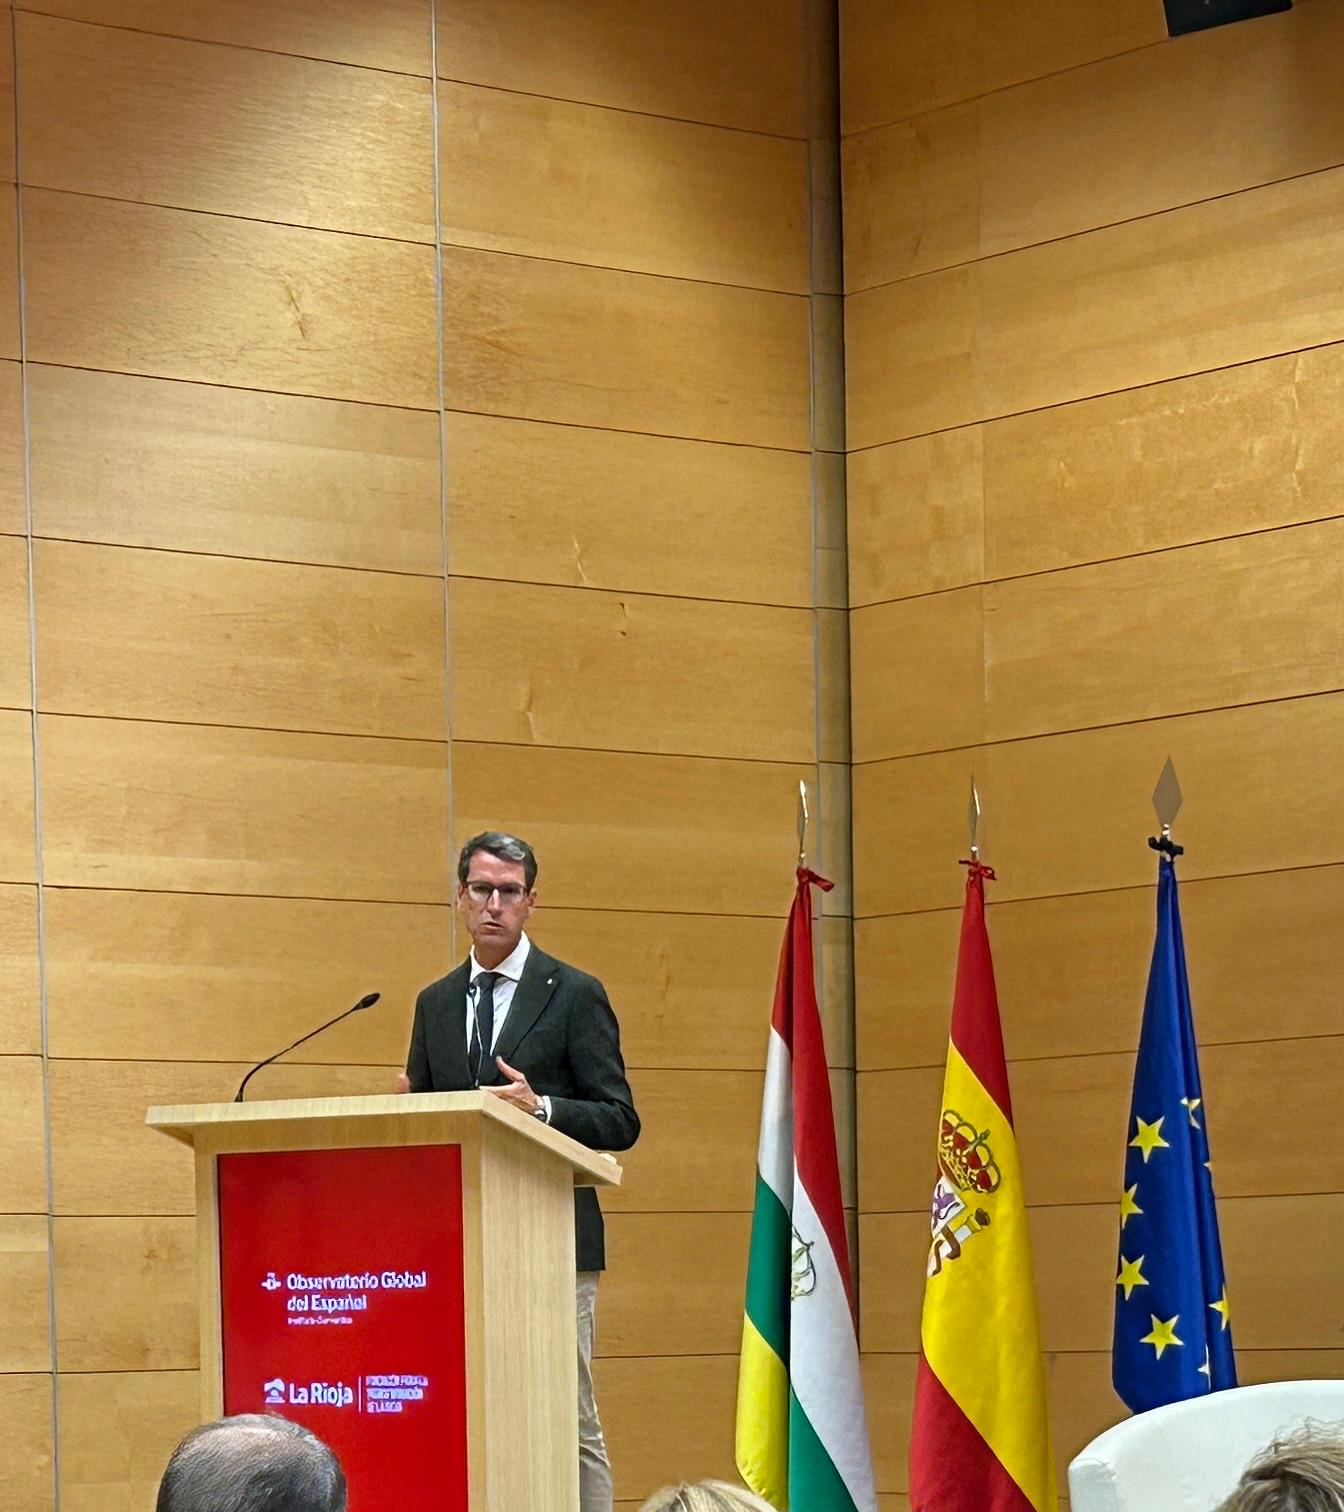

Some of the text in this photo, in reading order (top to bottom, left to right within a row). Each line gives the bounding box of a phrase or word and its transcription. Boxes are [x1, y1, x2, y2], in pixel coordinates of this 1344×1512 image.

[381, 1271, 428, 1289] Global
[287, 1294, 309, 1312] del
[289, 1382, 308, 1404] La
[310, 1381, 355, 1408] Rioja
